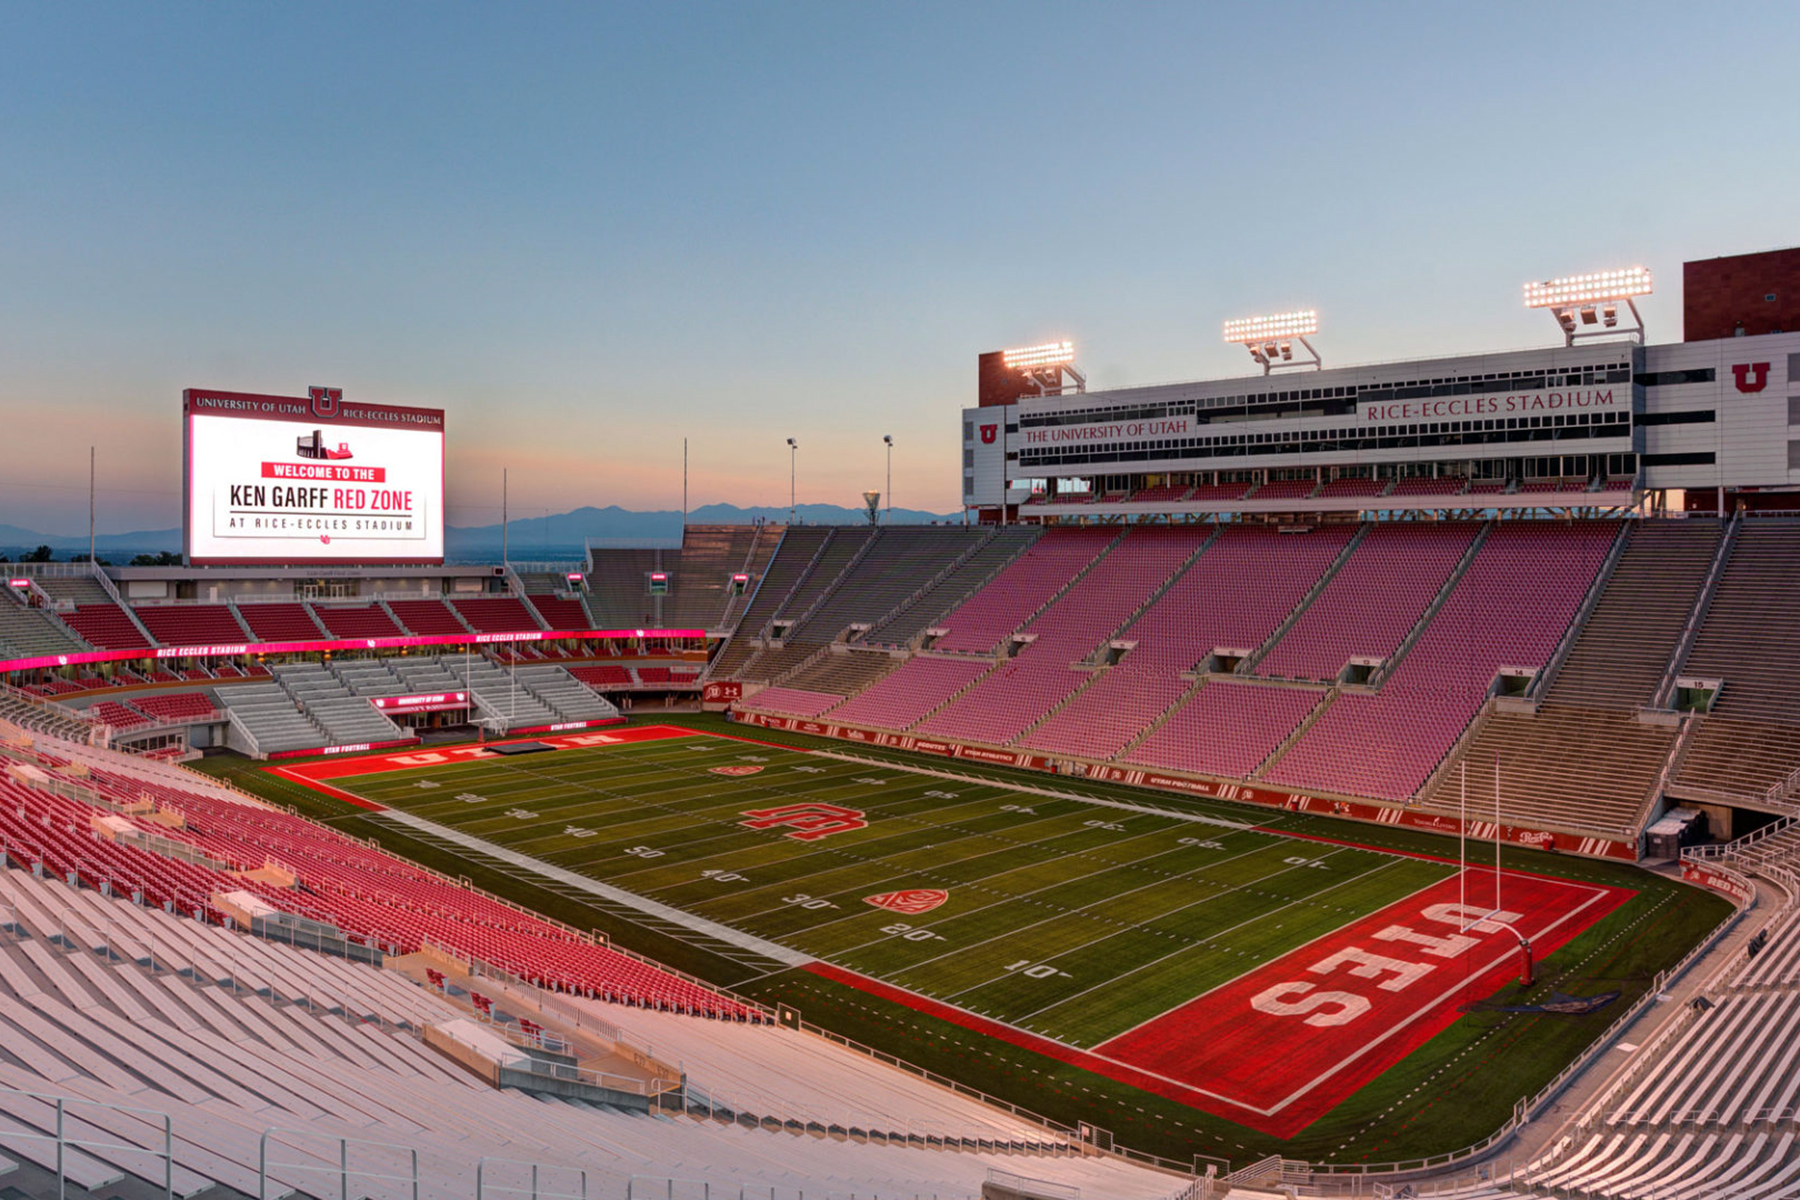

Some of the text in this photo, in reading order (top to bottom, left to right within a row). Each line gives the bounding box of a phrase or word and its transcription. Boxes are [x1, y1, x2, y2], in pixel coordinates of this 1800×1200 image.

[1732, 362, 1770, 393] U
[196, 397, 306, 414] UNIVERSITY OF UTAH
[309, 386, 342, 418] U
[1368, 390, 1614, 421] RICE-ECCLES STADIUM
[343, 409, 441, 424] RICE-ECCLES STADIUM
[979, 423, 998, 444] U
[1026, 420, 1187, 443] THE UNIVERSITY OF UTAH
[274, 464, 375, 480] WELCOME TO THE
[230, 485, 413, 511] KEN GARFF RED ZONE
[230, 518, 413, 531] AT RICE-ECCLES STADIUM
[515, 632, 542, 640] STADIUM
[157, 645, 246, 657] RICE ECCLES STADIUM
[324, 743, 370, 754] UTAH FOOTBALL
[388, 733, 625, 766] UTH
[981, 751, 1013, 761] ATHLETICS
[1150, 777, 1210, 792] UTAH FOOTBALL
[624, 845, 666, 858] 50
[700, 870, 742, 882] 40
[1707, 876, 1731, 890] RED
[781, 893, 832, 909] 30
[879, 923, 936, 941] 20
[1003, 960, 1059, 978] 10
[1250, 903, 1524, 1027] UTES
